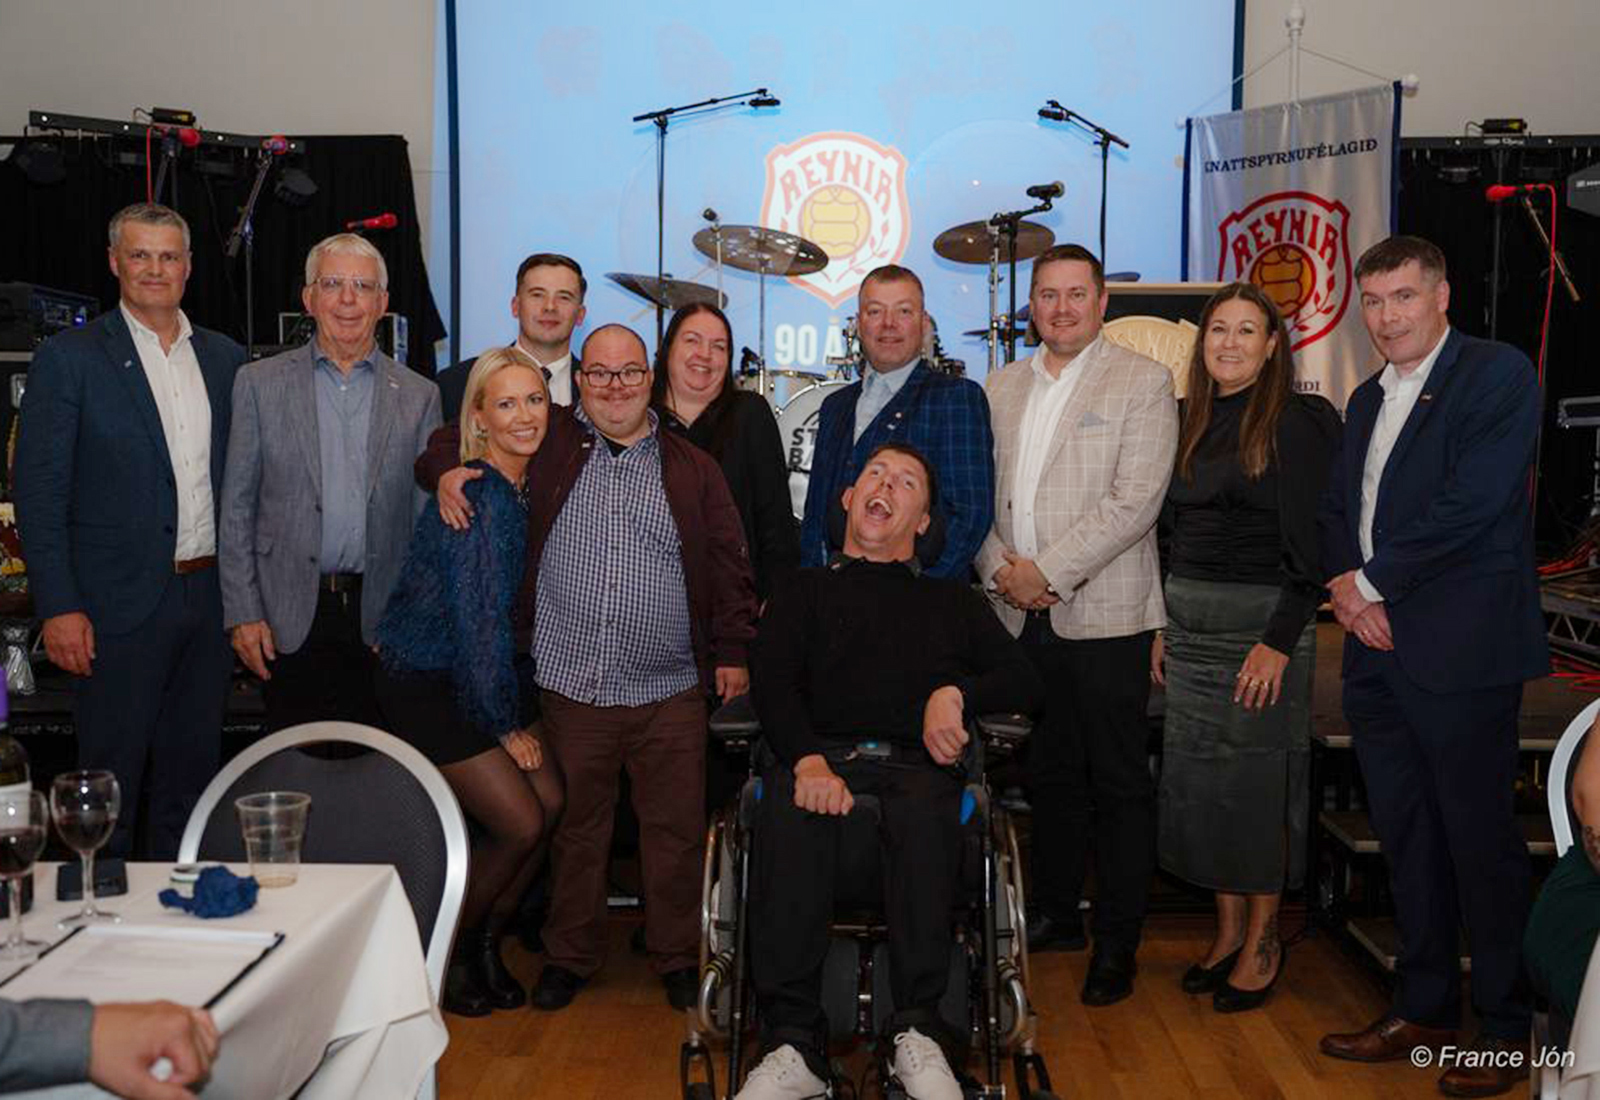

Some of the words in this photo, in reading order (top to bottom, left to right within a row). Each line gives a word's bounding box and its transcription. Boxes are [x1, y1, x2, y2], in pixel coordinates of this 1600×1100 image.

[779, 150, 892, 214] REYNIR
[1232, 208, 1339, 279] REYNIR
[774, 323, 817, 366] 90
